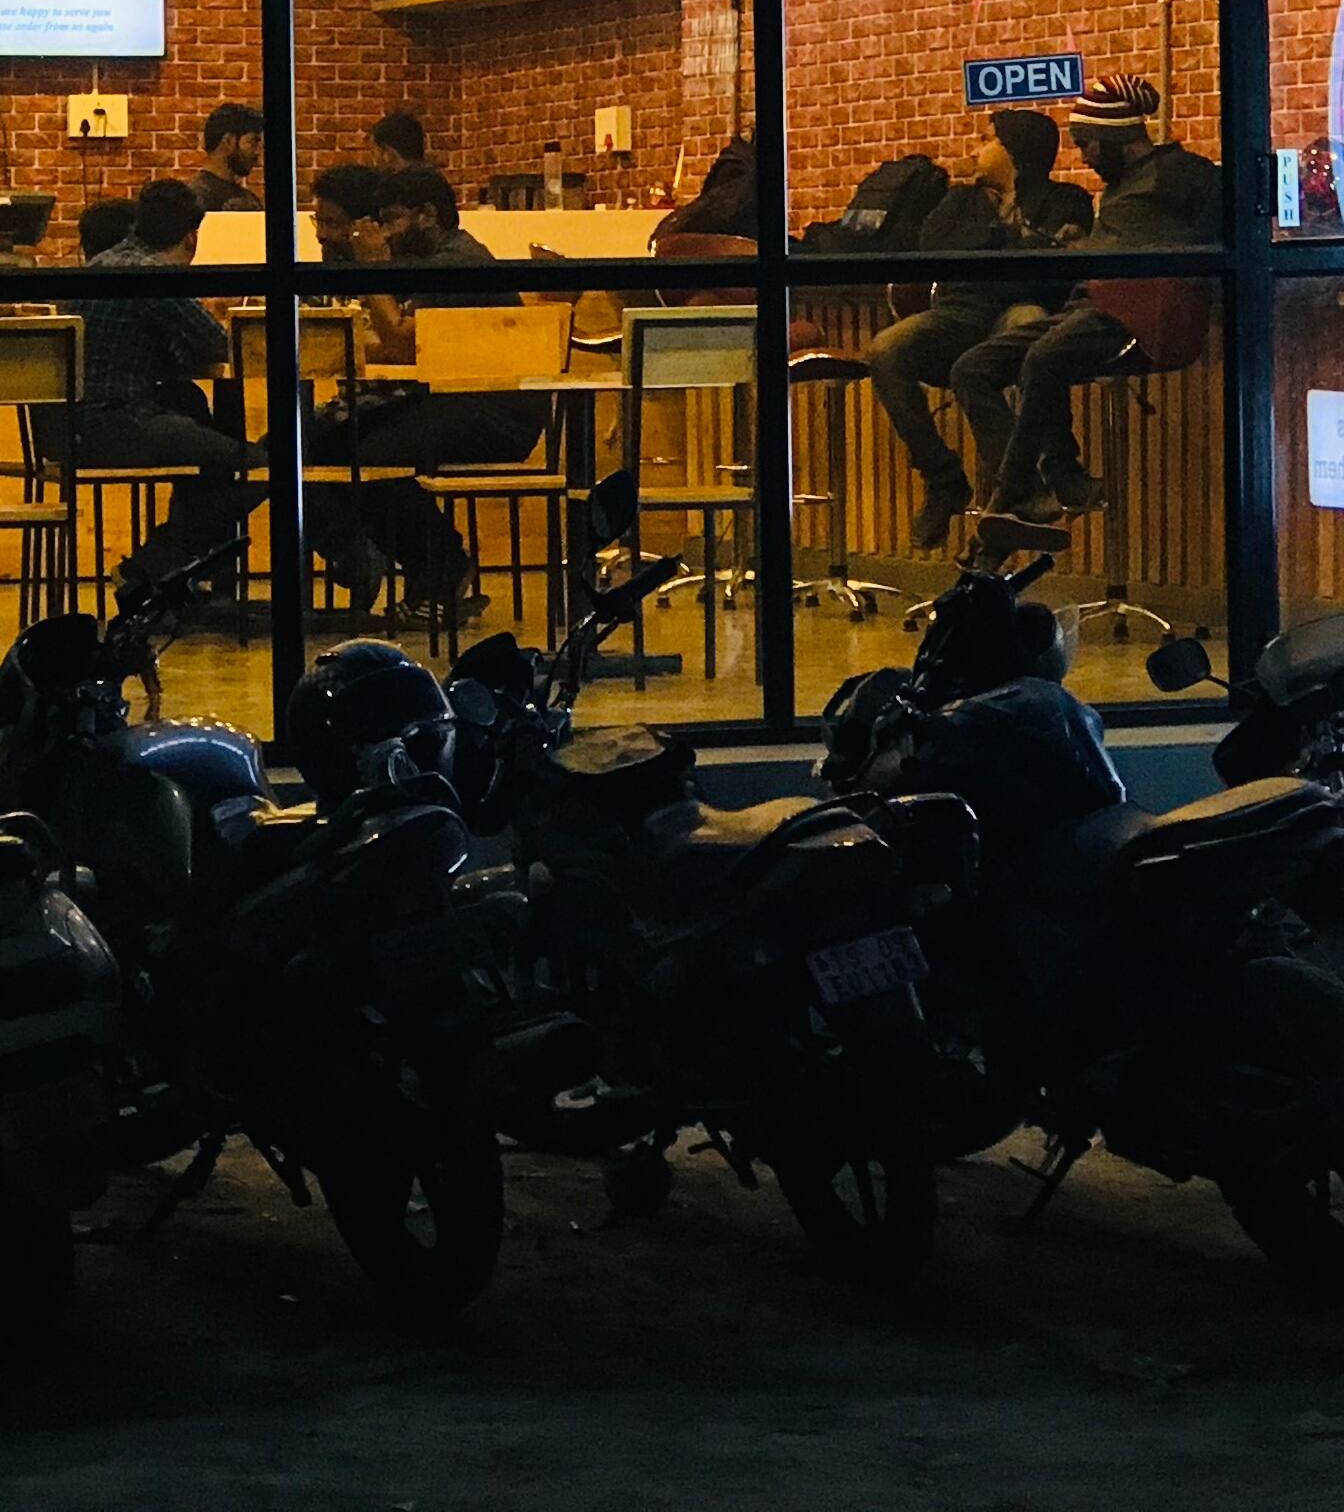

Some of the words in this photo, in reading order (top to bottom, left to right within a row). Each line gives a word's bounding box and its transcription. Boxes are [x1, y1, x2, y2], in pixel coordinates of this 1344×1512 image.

[20, 6, 50, 18] happy
[52, 7, 62, 16] to
[44, 21, 69, 32] from
[978, 60, 1072, 96] OPEN
[1282, 155, 1294, 221] PUSH
